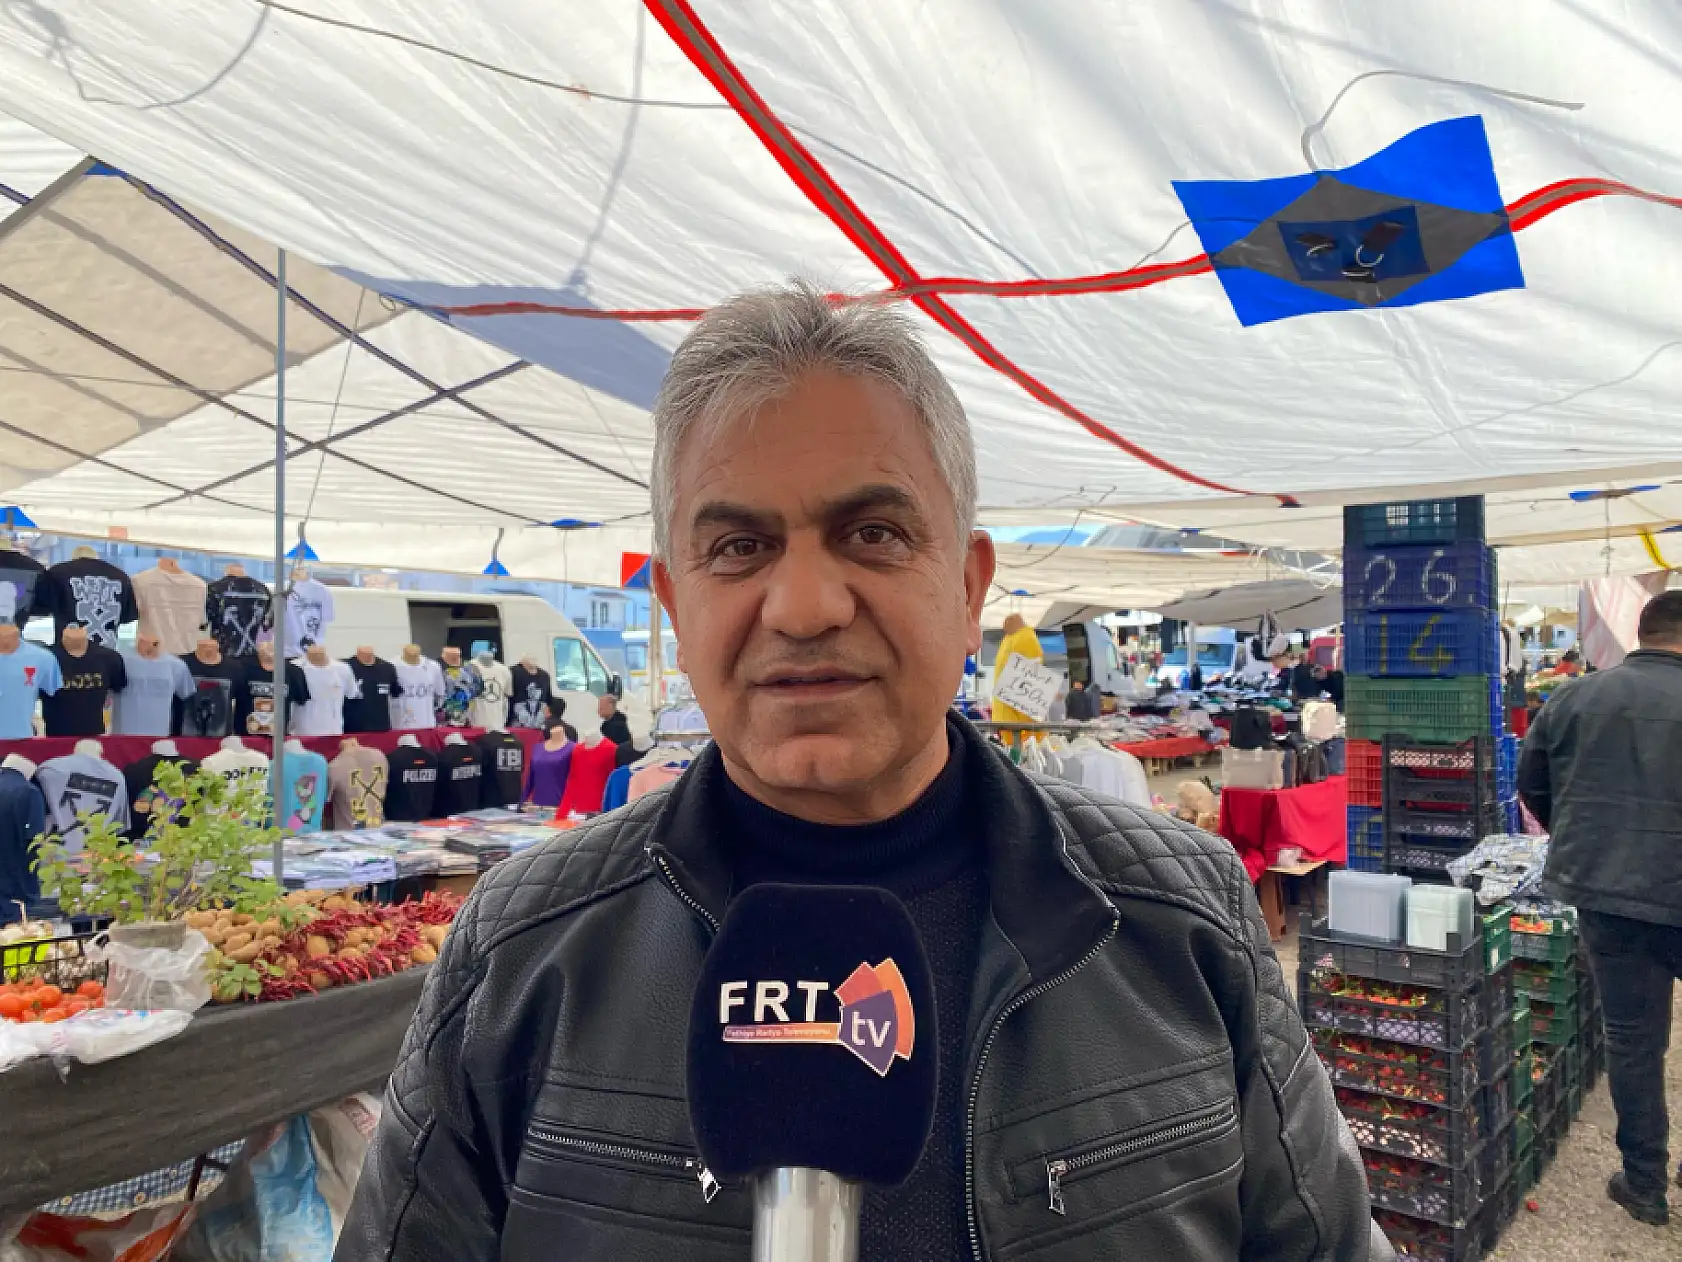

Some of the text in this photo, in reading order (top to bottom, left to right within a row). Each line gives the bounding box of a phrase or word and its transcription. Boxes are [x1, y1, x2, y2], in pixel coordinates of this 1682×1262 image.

[1379, 613, 1455, 675] 14
[719, 980, 829, 1024] FRT
[851, 1011, 892, 1048] tv
